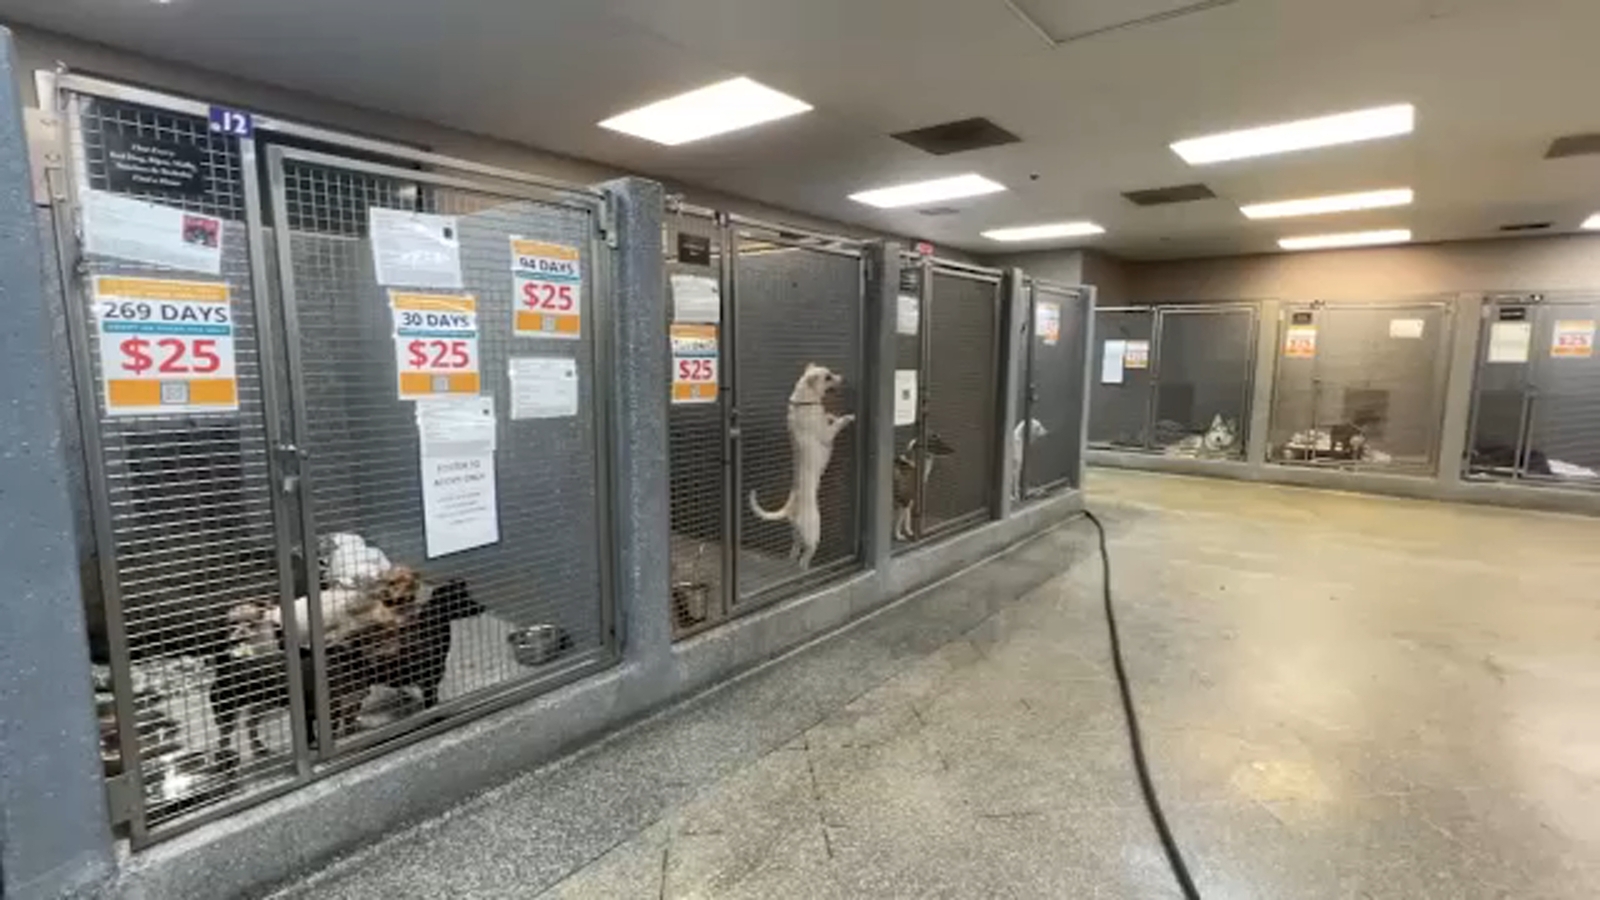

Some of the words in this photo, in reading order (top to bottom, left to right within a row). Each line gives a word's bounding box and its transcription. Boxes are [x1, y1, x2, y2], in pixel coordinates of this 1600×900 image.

[520, 256, 537, 270] 94
[539, 259, 575, 275] DAYS
[522, 281, 574, 311] $25
[102, 301, 152, 320] 269
[160, 303, 229, 323] DAYS
[401, 311, 423, 327] 30
[426, 314, 470, 329] DAYS
[119, 334, 221, 376] $25
[407, 339, 471, 370] $25
[678, 359, 714, 381] $25
